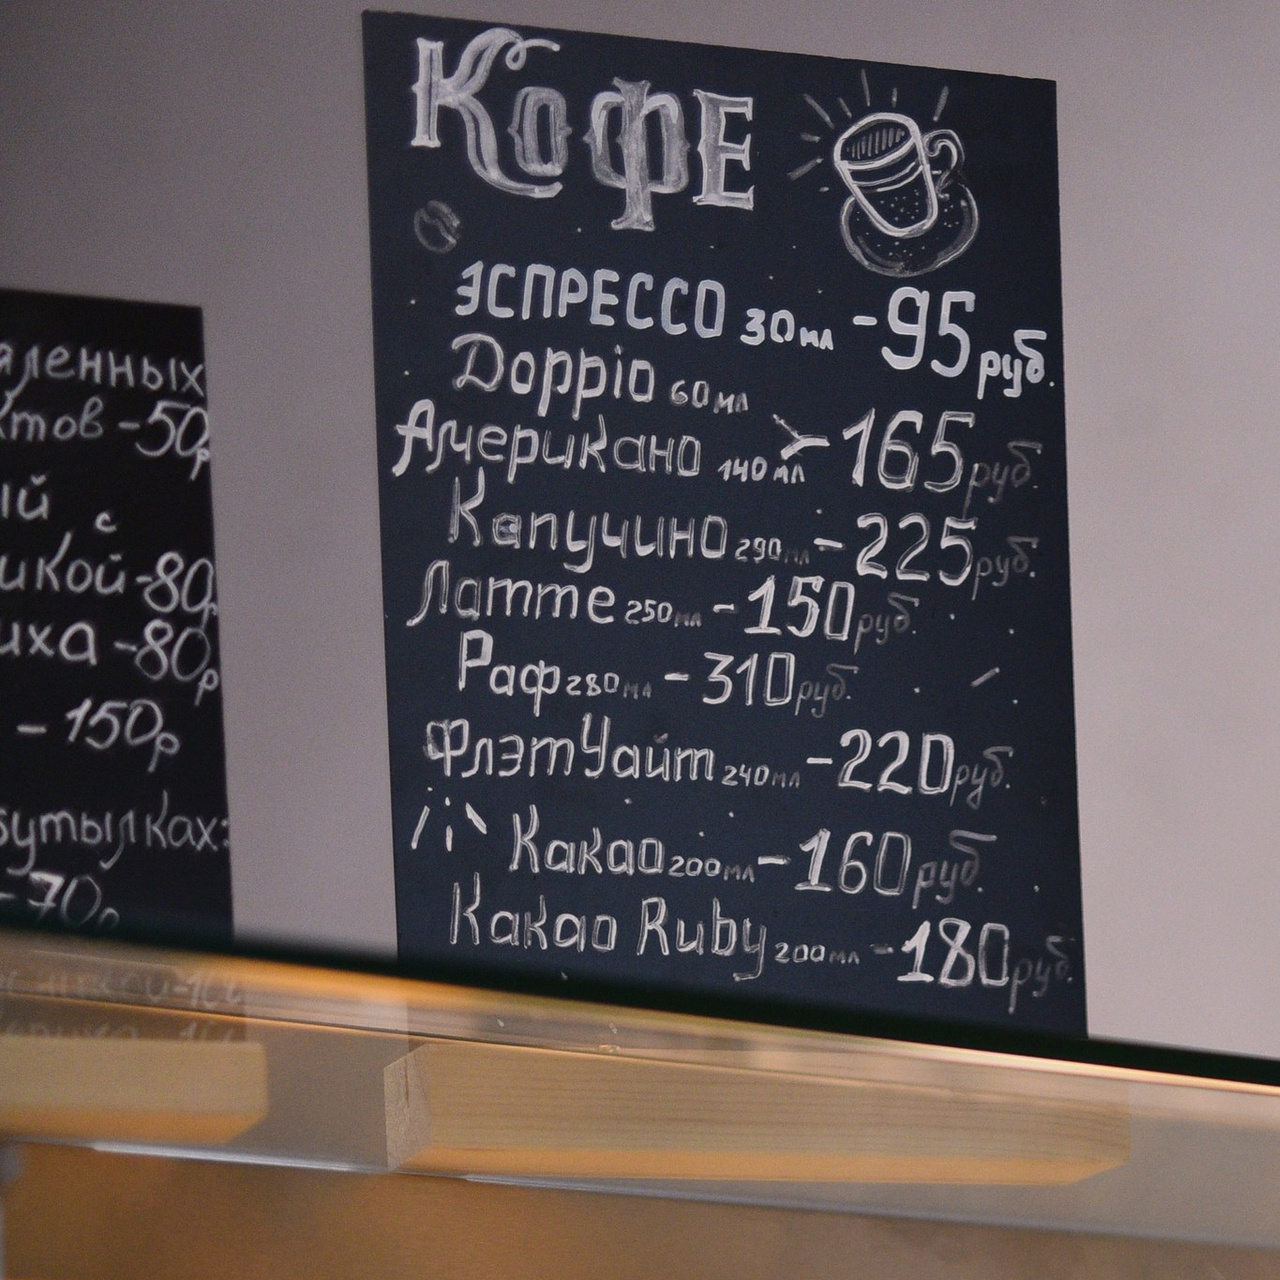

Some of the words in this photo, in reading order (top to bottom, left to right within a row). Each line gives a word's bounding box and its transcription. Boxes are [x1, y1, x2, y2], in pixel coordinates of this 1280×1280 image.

[455, 261, 726, 338] ЭСПРЕССО
[452, 333, 654, 417] Doppio
[0, 396, 103, 442] тов
[393, 399, 701, 484] Американо
[448, 469, 728, 572] Капучино
[407, 559, 615, 626] Латте
[458, 630, 563, 717] Раф
[509, 804, 665, 875] Какао
[449, 871, 615, 954] Какао
[637, 897, 769, 982] Ruby
